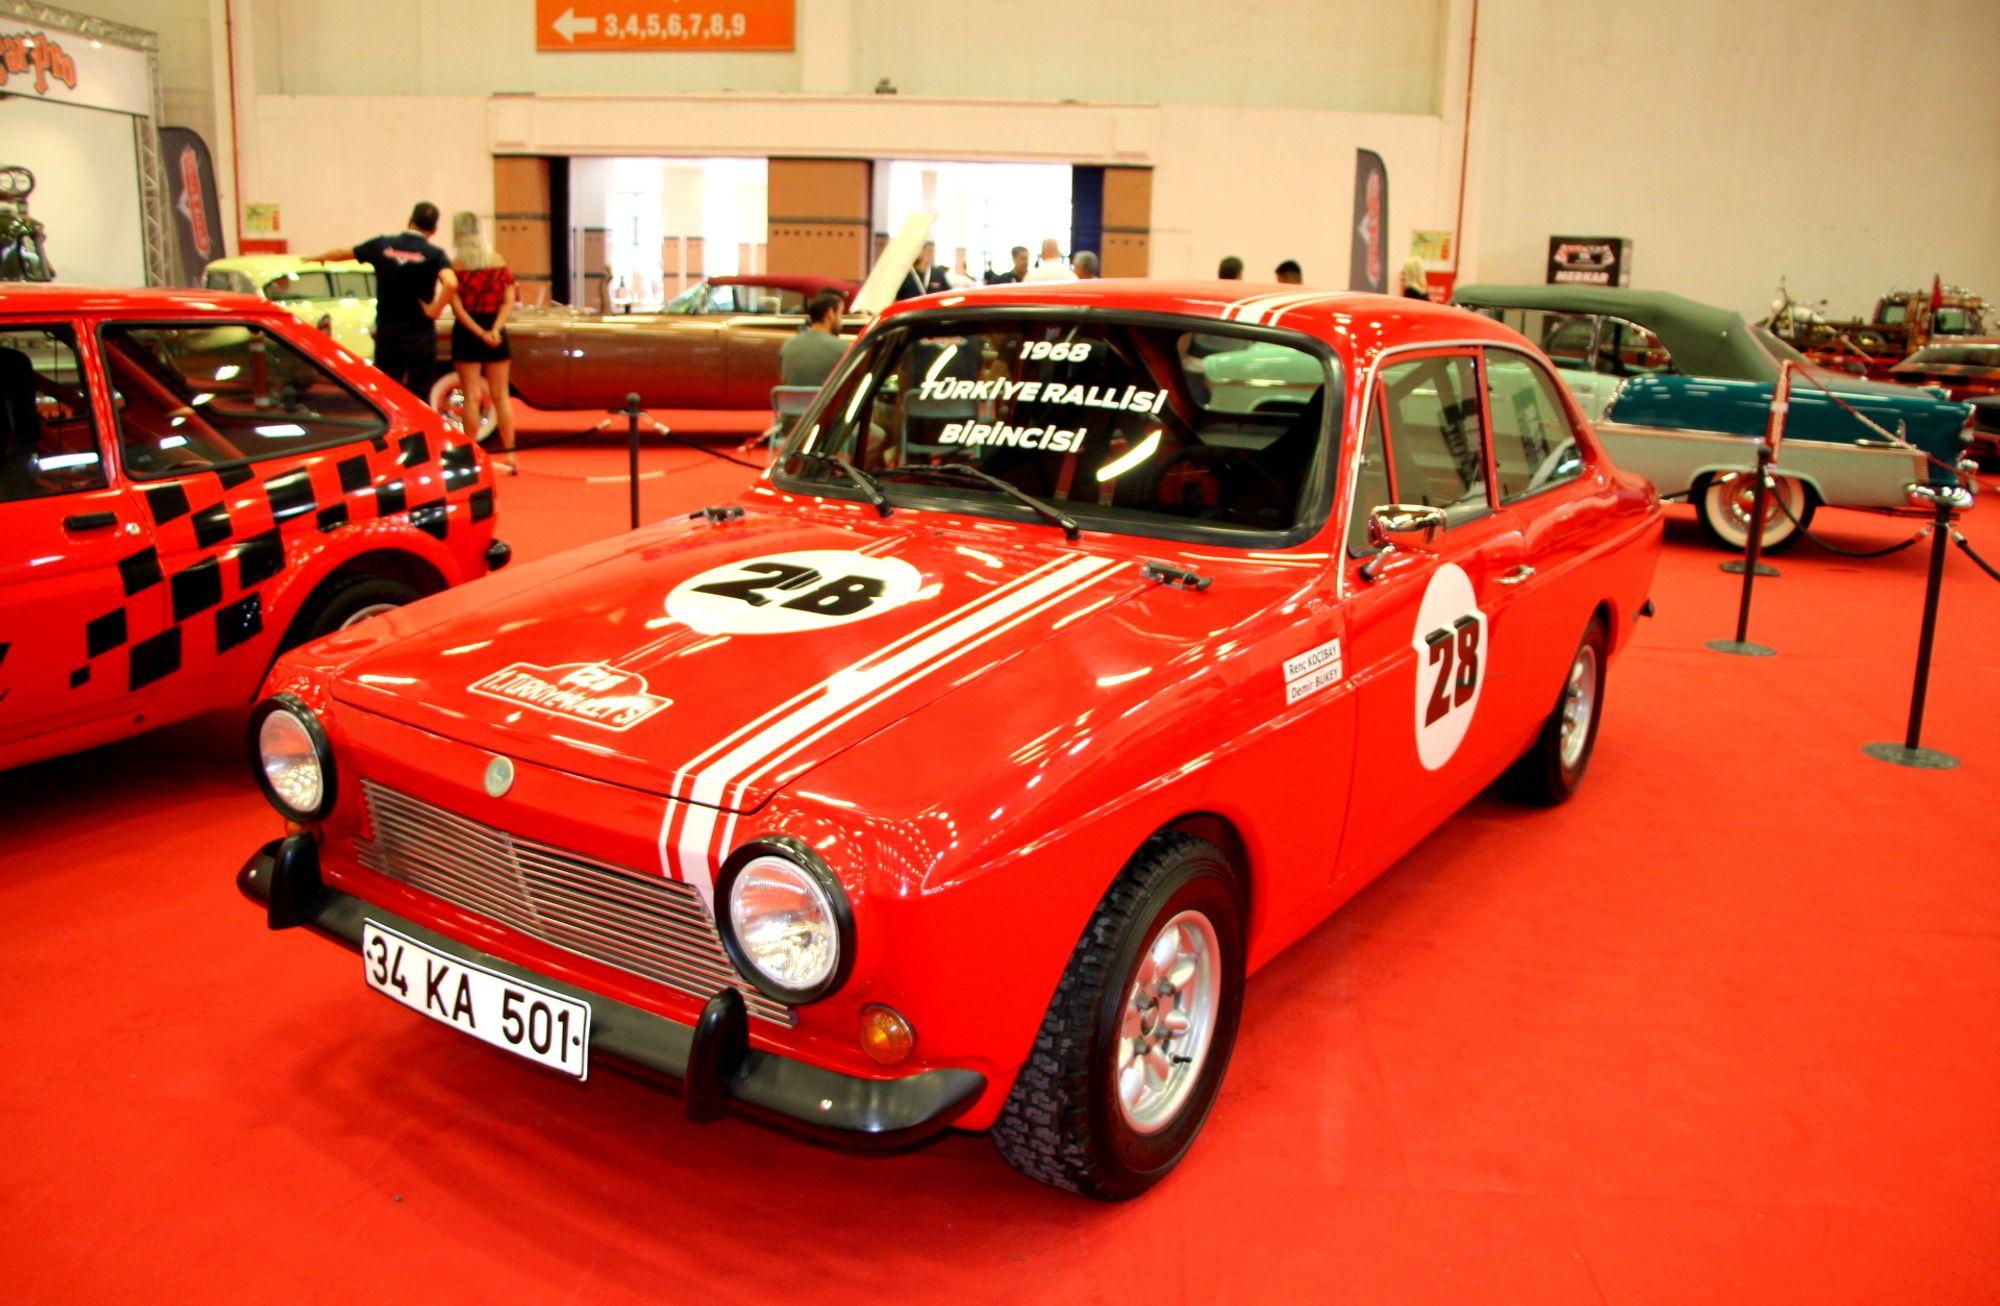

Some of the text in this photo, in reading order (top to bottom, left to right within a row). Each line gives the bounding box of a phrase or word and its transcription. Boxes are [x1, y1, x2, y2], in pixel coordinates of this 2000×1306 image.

[604, 13, 746, 40] 3,4,5,6,7,8,9
[1019, 341, 1092, 363] 1968
[919, 376, 1169, 414] TÜRKİYE RALLİSİ
[937, 419, 1088, 454] BİRİNCİSİ
[1425, 613, 1480, 728] 28
[371, 935, 570, 1063] 34 KA 501
